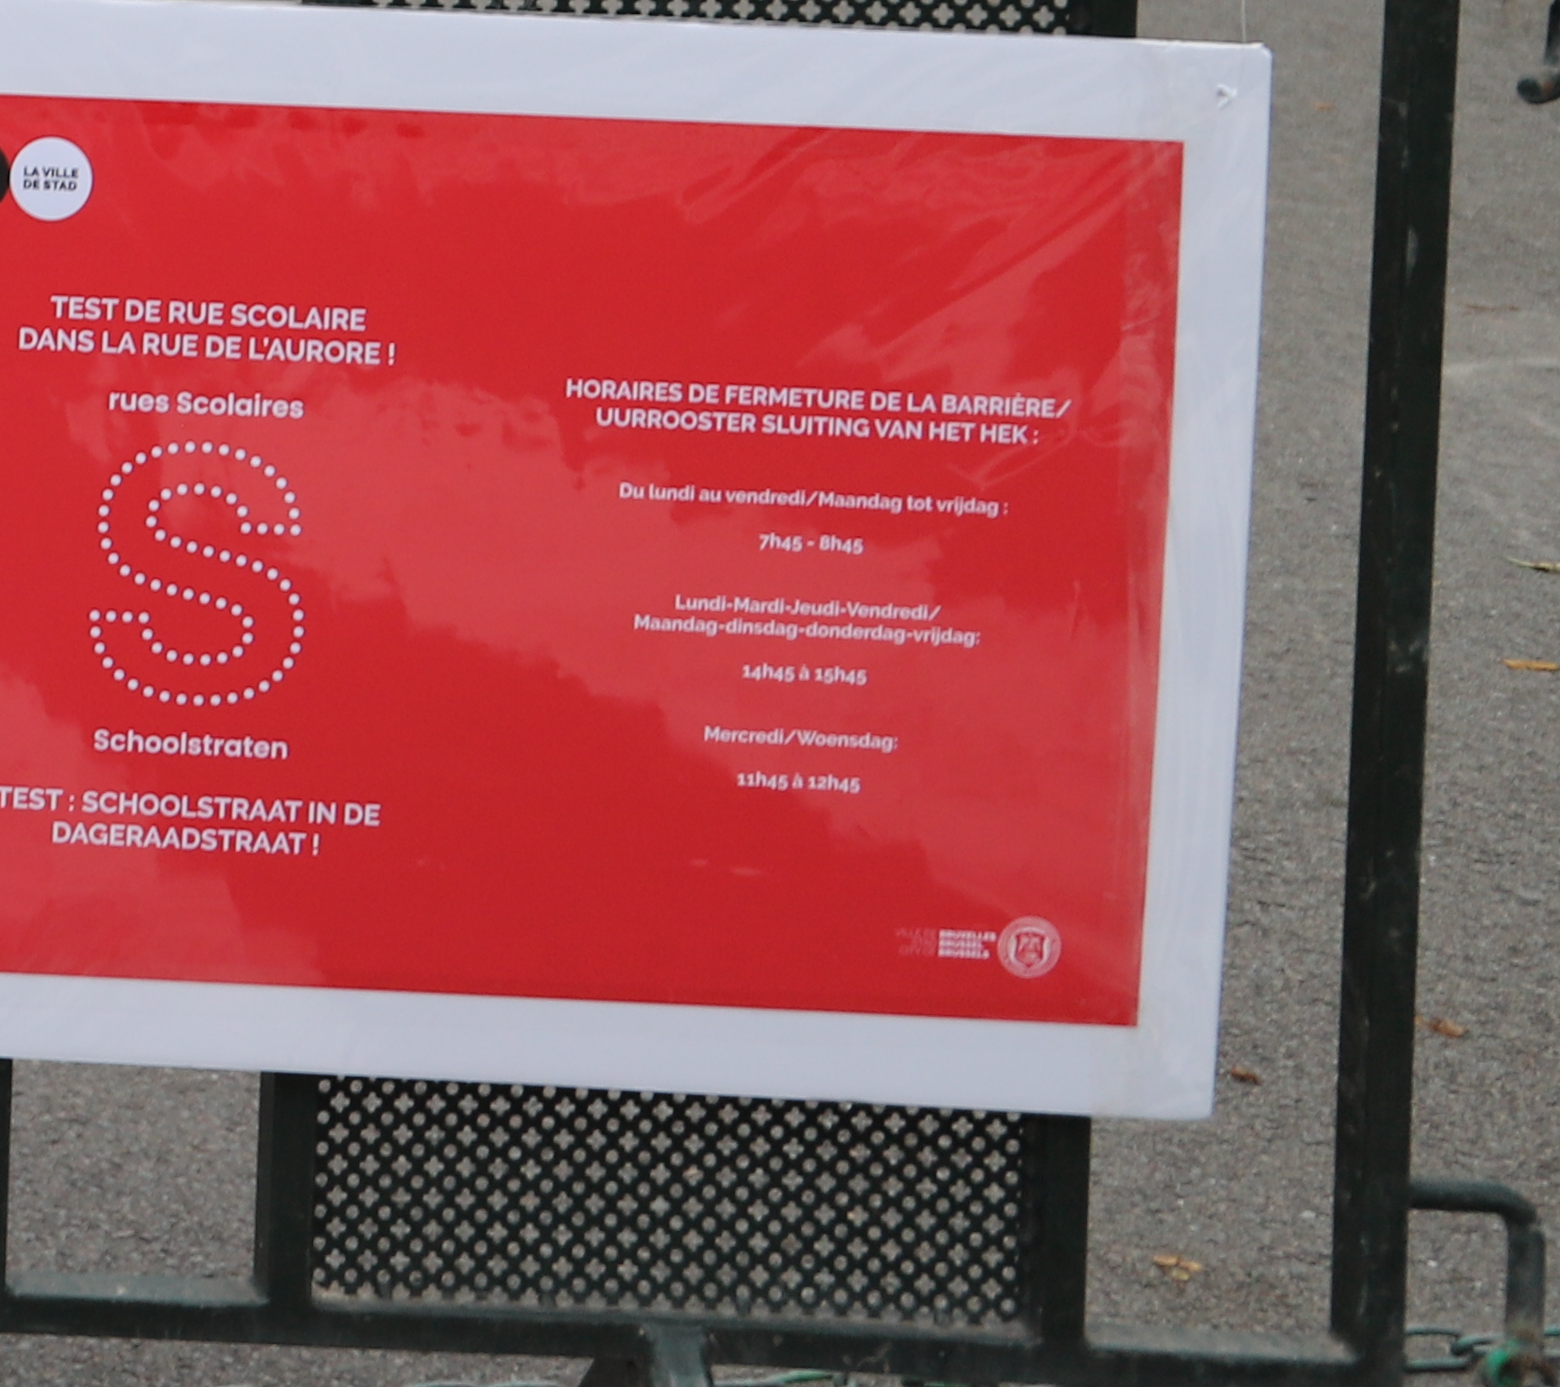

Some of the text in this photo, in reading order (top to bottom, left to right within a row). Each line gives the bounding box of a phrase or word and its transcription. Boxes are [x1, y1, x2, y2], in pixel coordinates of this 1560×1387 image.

[23, 166, 79, 179] LA VILLE
[23, 179, 77, 191] DE STAD
[50, 295, 367, 332] TEST DE RUE SCOLAIRE
[18, 327, 396, 366] DANS LA RUE DE L'AURORE !
[109, 390, 304, 419] rues Scolaires
[565, 378, 1072, 419] HORAIRES DE FERMETURE DE LA BARRIÈRE/
[596, 406, 756, 433] UURROOSTER
[761, 413, 870, 439] SLUITING
[875, 419, 922, 440] VAN
[928, 422, 975, 443] HET
[980, 424, 1029, 445] HEK
[619, 481, 644, 501] Du
[648, 482, 695, 502] lundi
[699, 489, 722, 504] au
[725, 488, 903, 514] vendredi/Maandag
[906, 495, 933, 513] tot
[936, 496, 999, 518] vrijdag
[759, 532, 803, 553] 7h45
[819, 534, 864, 556] 8h45
[88, 440, 305, 707] S
[674, 594, 942, 621] Lundi-Mardi-Jeudi-Vendredi/
[742, 662, 867, 686] 14h45 à 15h45
[93, 728, 288, 760] Schoolstraten
[737, 771, 861, 794] 11h45 à 12h45
[81, 790, 303, 823] SCHOOLSTRAAT
[308, 802, 336, 825] IN
[344, 803, 381, 827] DE
[51, 821, 307, 855] DAGERAADSTRAAT
